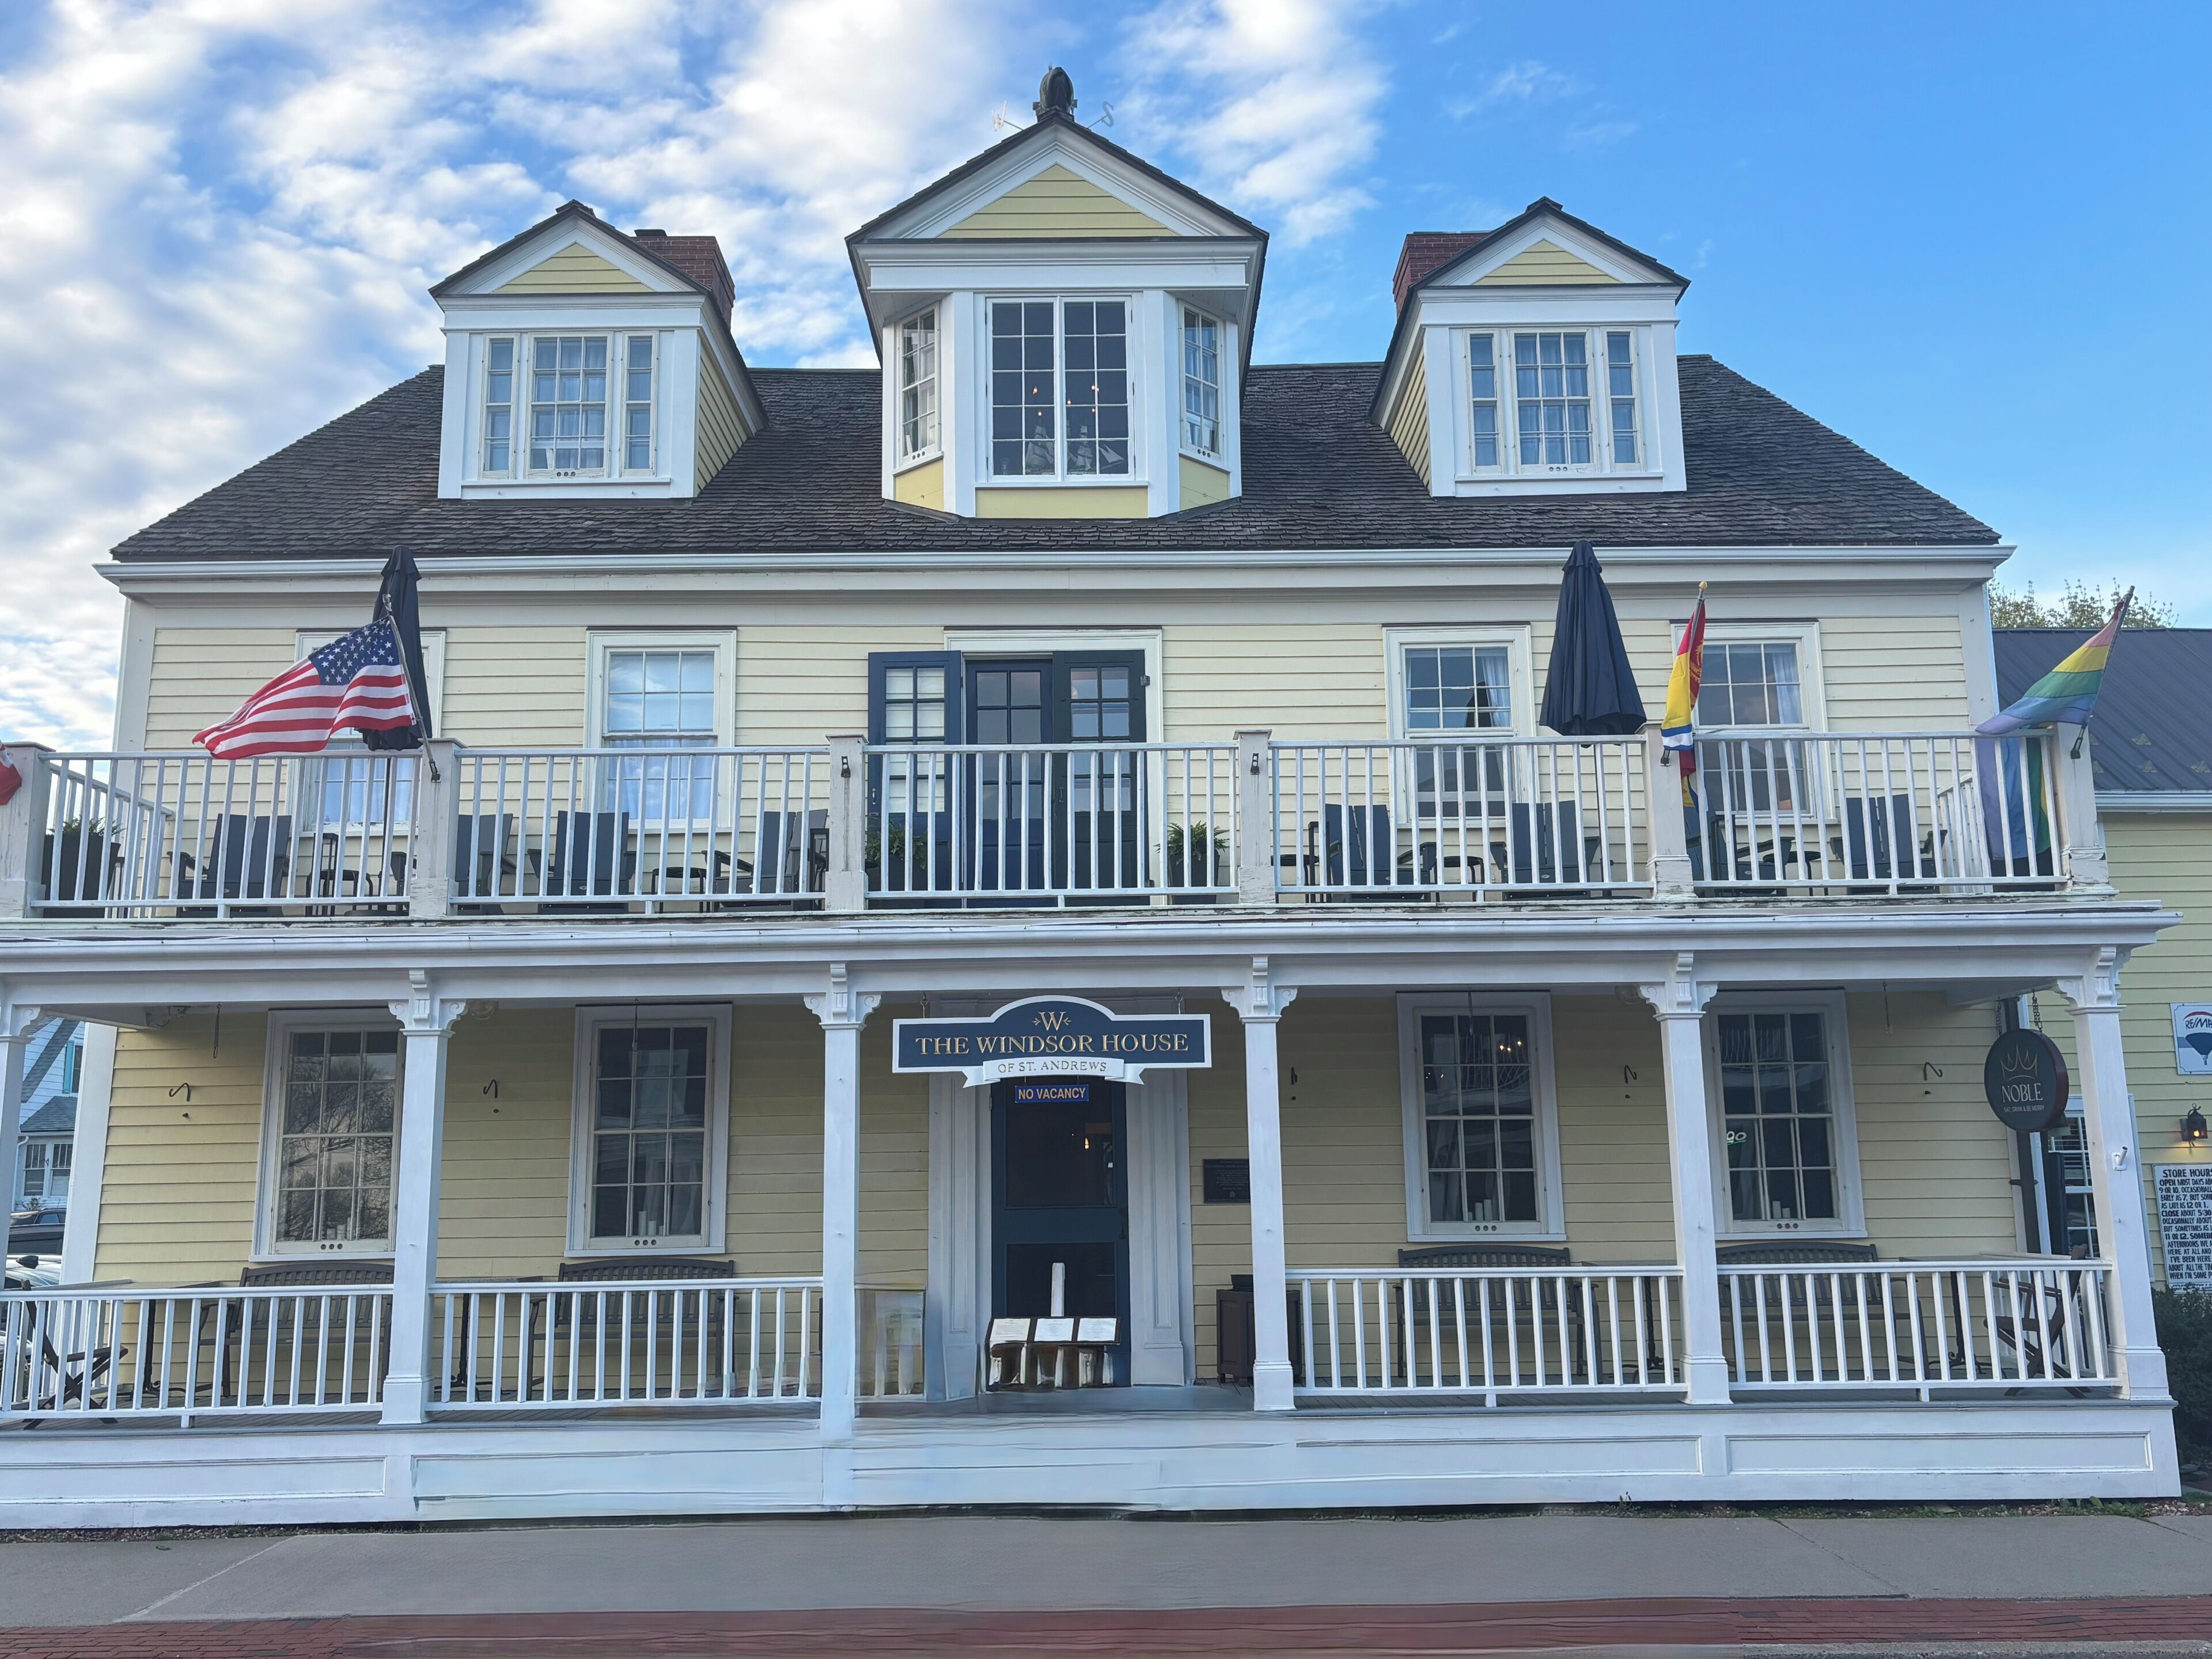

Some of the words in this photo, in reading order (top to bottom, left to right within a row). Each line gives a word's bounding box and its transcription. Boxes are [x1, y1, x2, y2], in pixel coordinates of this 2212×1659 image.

[915, 1037, 969, 1054] THE
[976, 1035, 1094, 1054] WINDSOR
[1102, 1033, 1189, 1052] HOUSE
[998, 1063, 1015, 1073] OF
[1019, 1062, 1037, 1072] ST.
[1041, 1060, 1107, 1072] ANDREWS
[1018, 1088, 1034, 1100] NO
[1036, 1087, 1086, 1100] VACANCY
[2002, 1083, 2043, 1103] NOBLE
[2162, 1169, 2187, 1177] STORE
